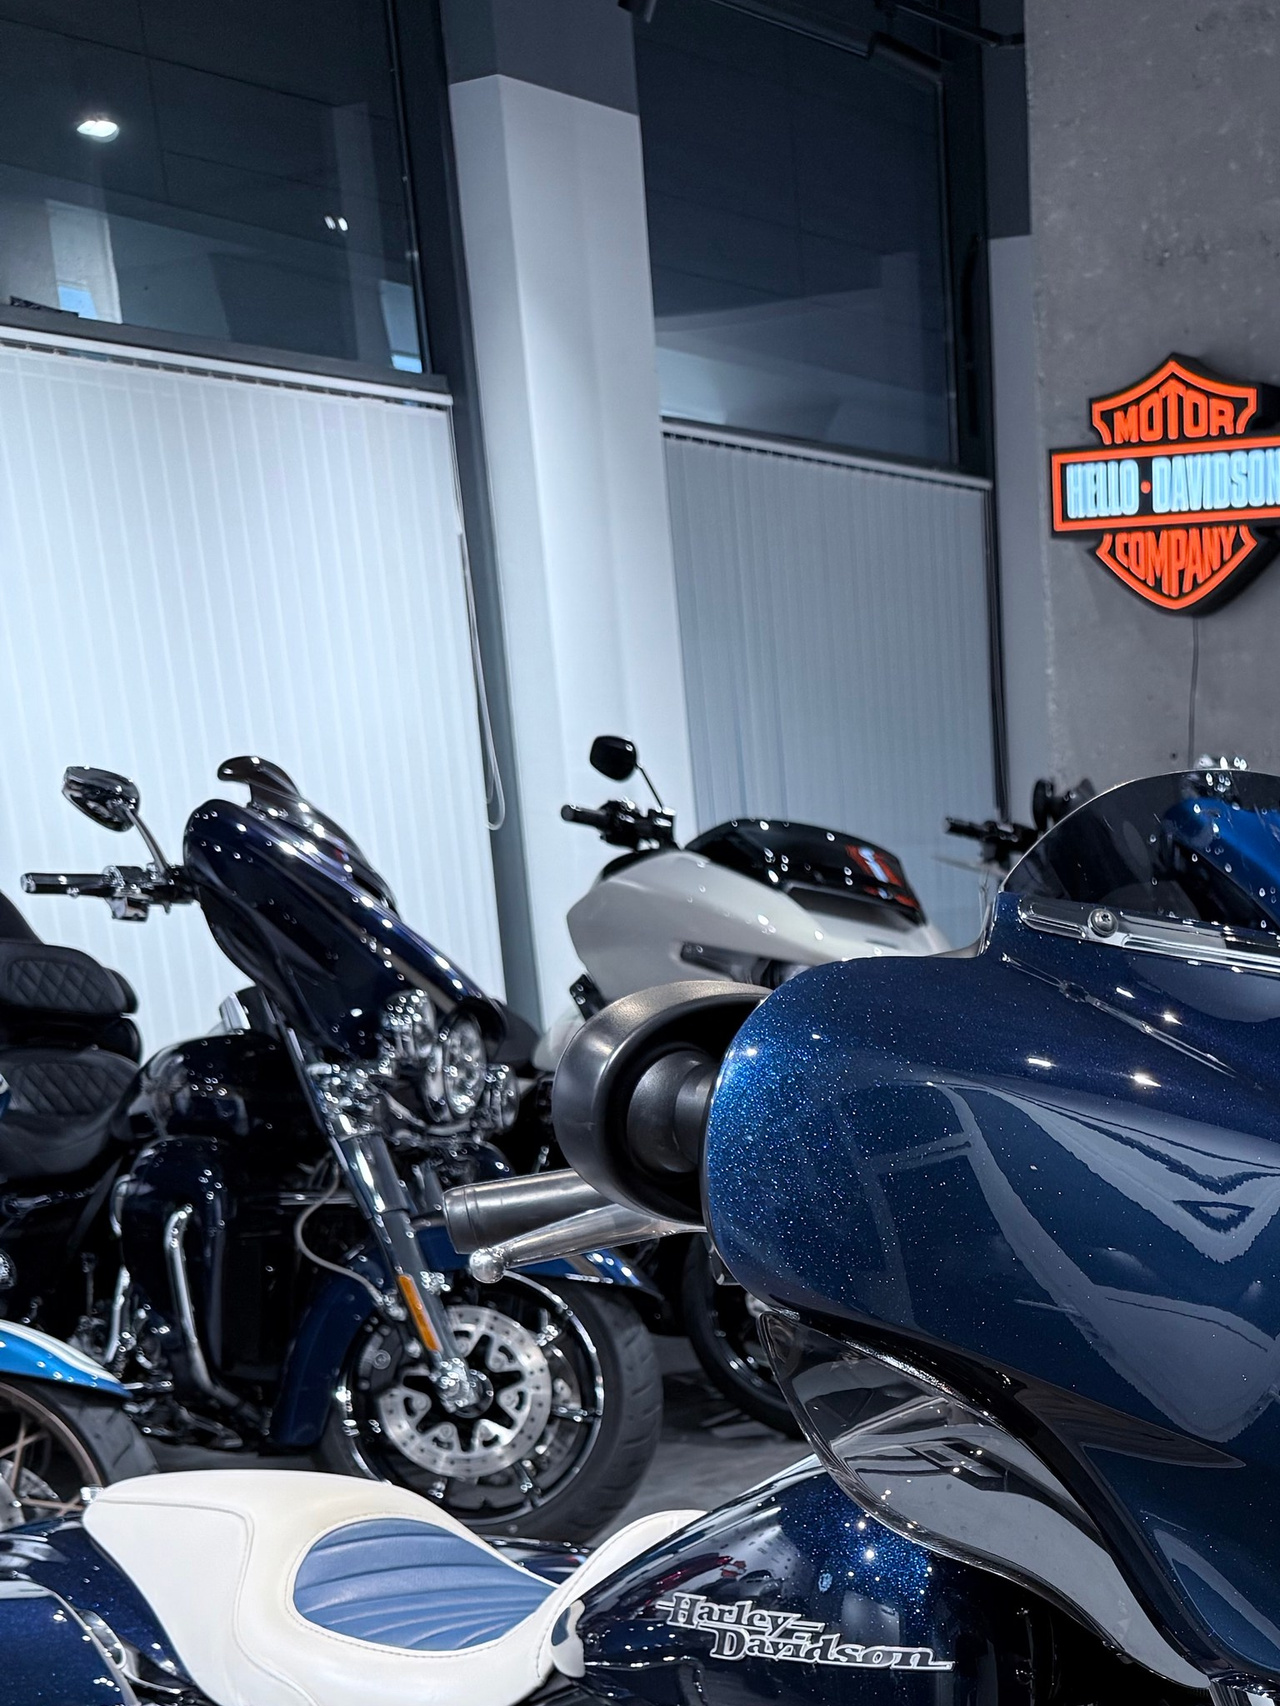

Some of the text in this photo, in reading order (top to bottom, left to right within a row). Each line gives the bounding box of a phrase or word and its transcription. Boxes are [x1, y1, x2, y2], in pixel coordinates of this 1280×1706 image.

[1113, 379, 1234, 444] MOTOR
[1066, 459, 1139, 519] HELLO
[1115, 525, 1237, 597] COMPANY
[658, 1592, 822, 1638] Harley
[702, 1625, 954, 1670] Davidson
